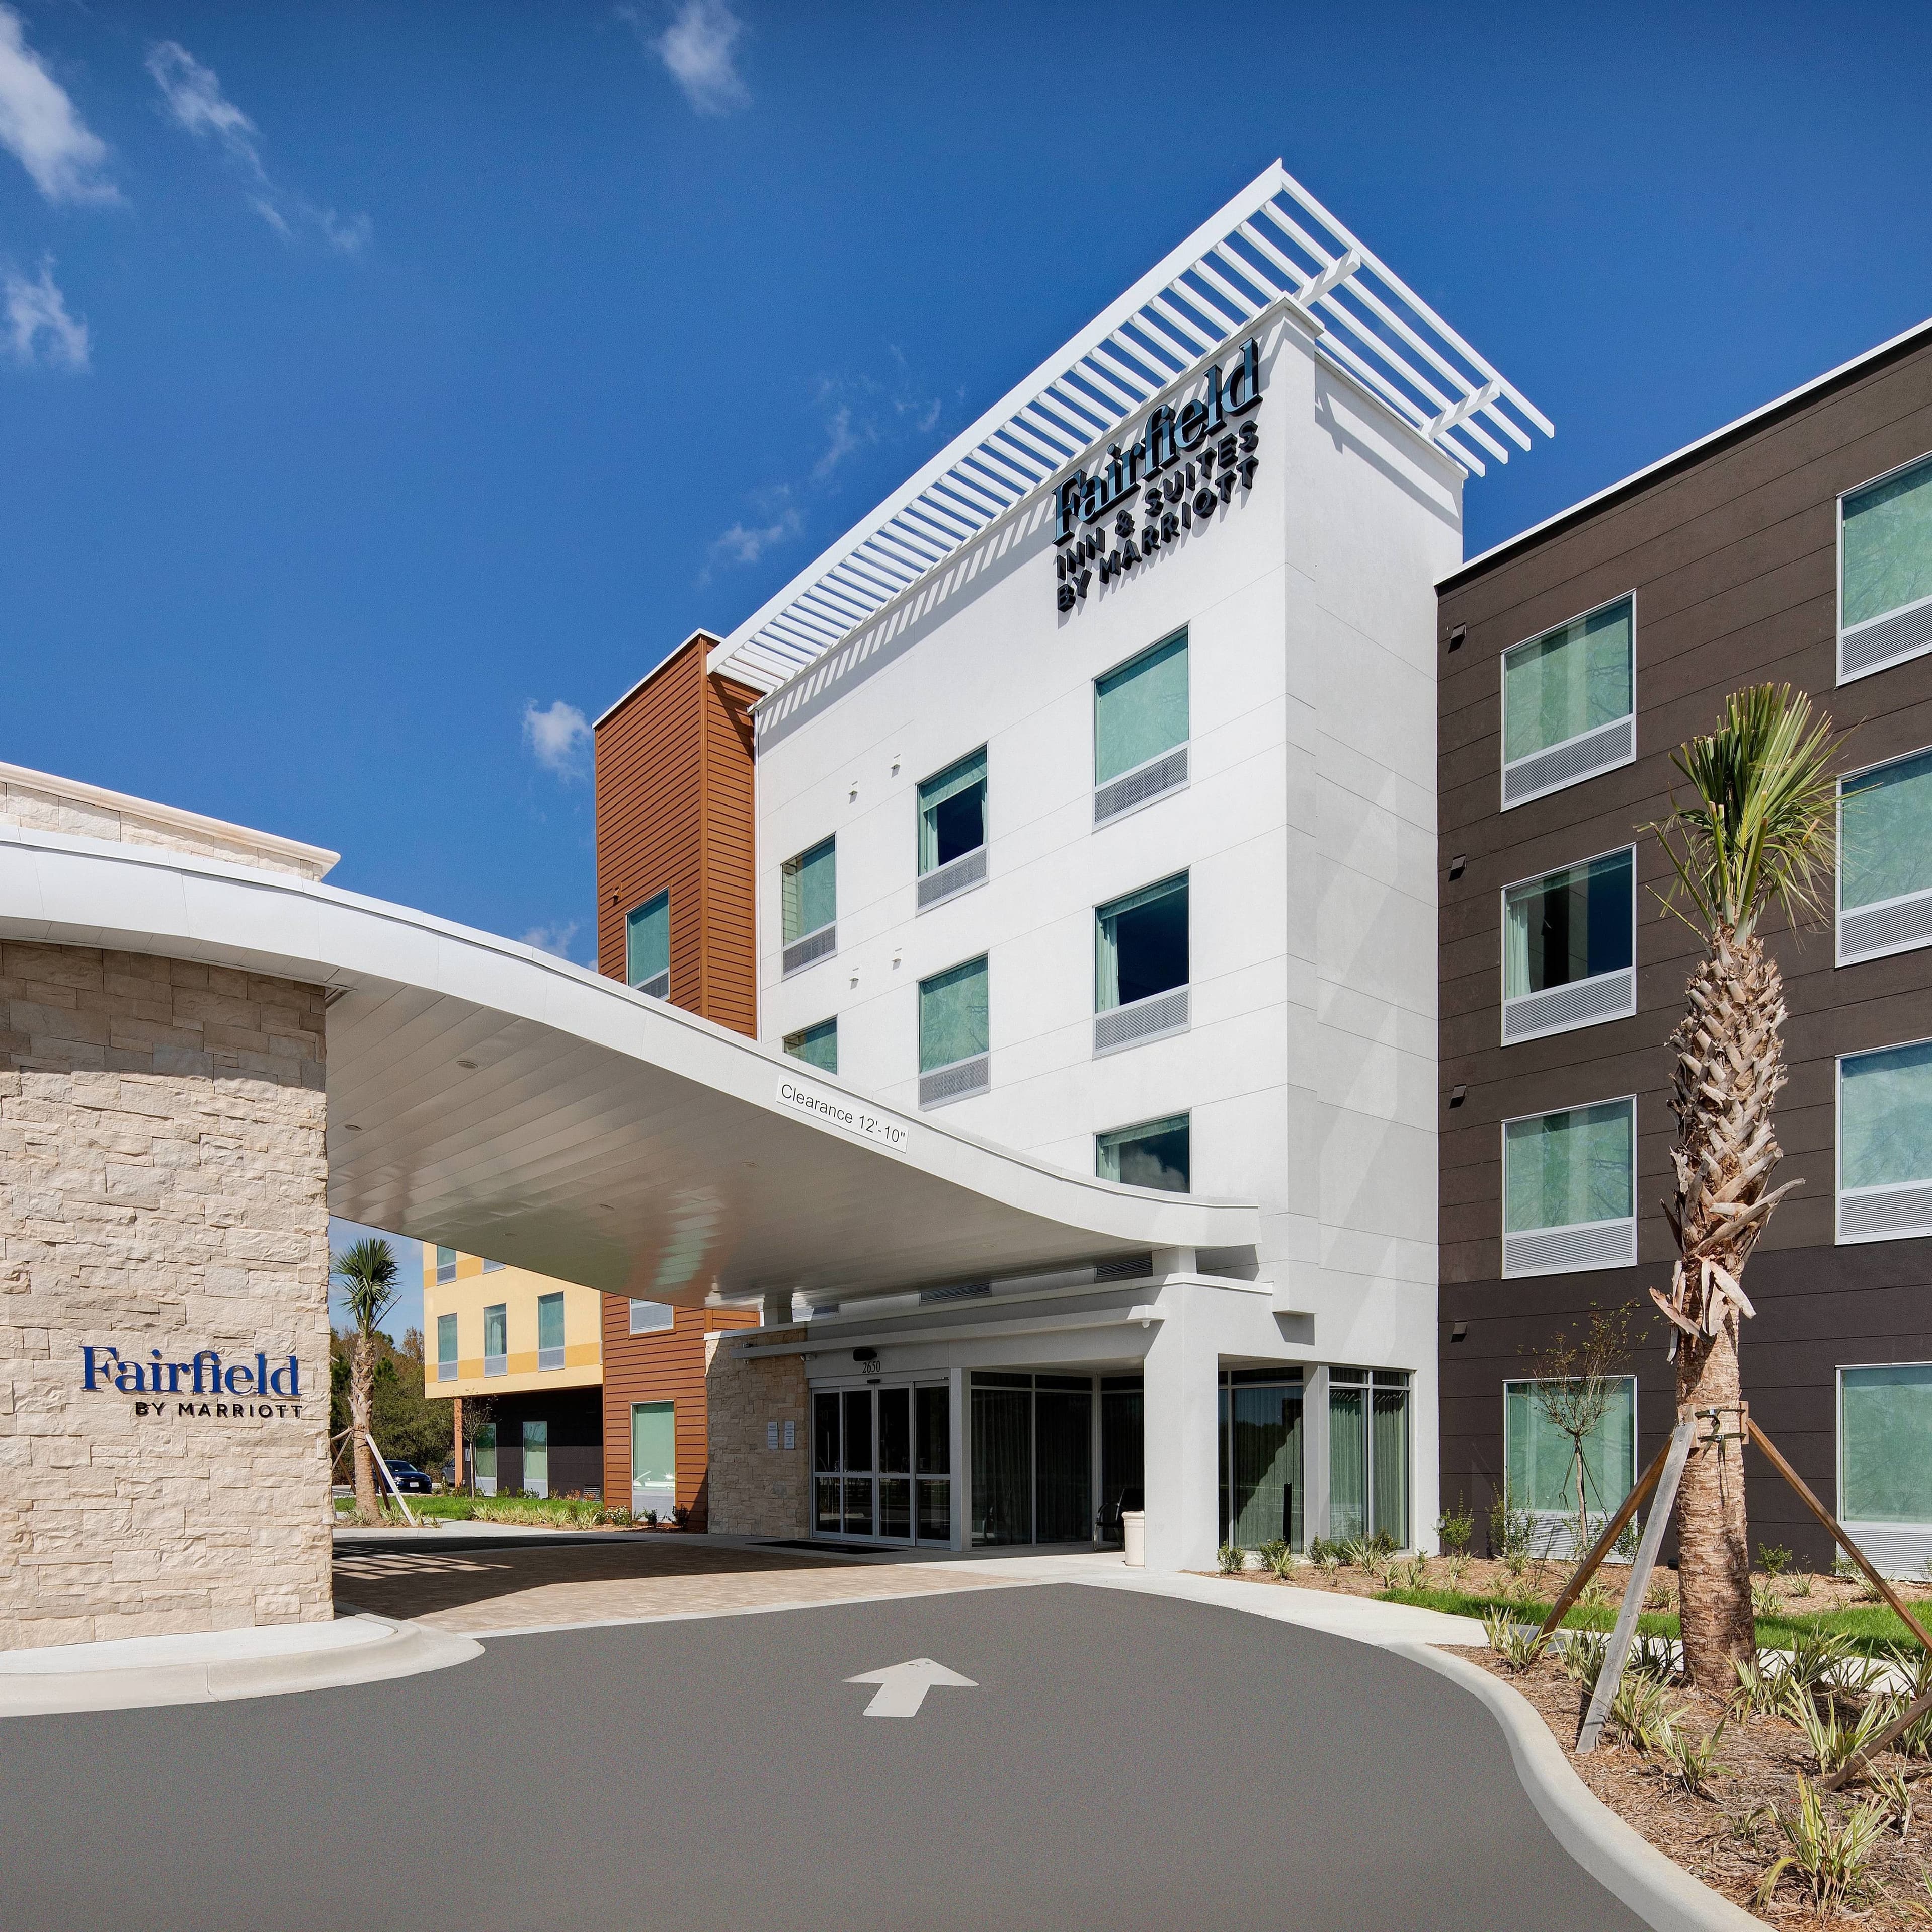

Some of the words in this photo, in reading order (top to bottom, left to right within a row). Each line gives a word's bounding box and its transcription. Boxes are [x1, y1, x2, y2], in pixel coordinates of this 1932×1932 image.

[1052, 337, 1262, 546] Fairfield
[1057, 527, 1105, 580] INN
[1115, 509, 1135, 538] &
[1145, 420, 1259, 517] SUITES
[1057, 569, 1092, 612] BY
[1099, 455, 1259, 584] MARRIOTT
[781, 1084, 853, 1124] Clearance
[859, 1115, 906, 1143] 12'-10"
[78, 1346, 301, 1397] Fairfield
[862, 1360, 880, 1373] 2650
[135, 1401, 166, 1417] BY
[178, 1402, 302, 1419] MARRIOTT
